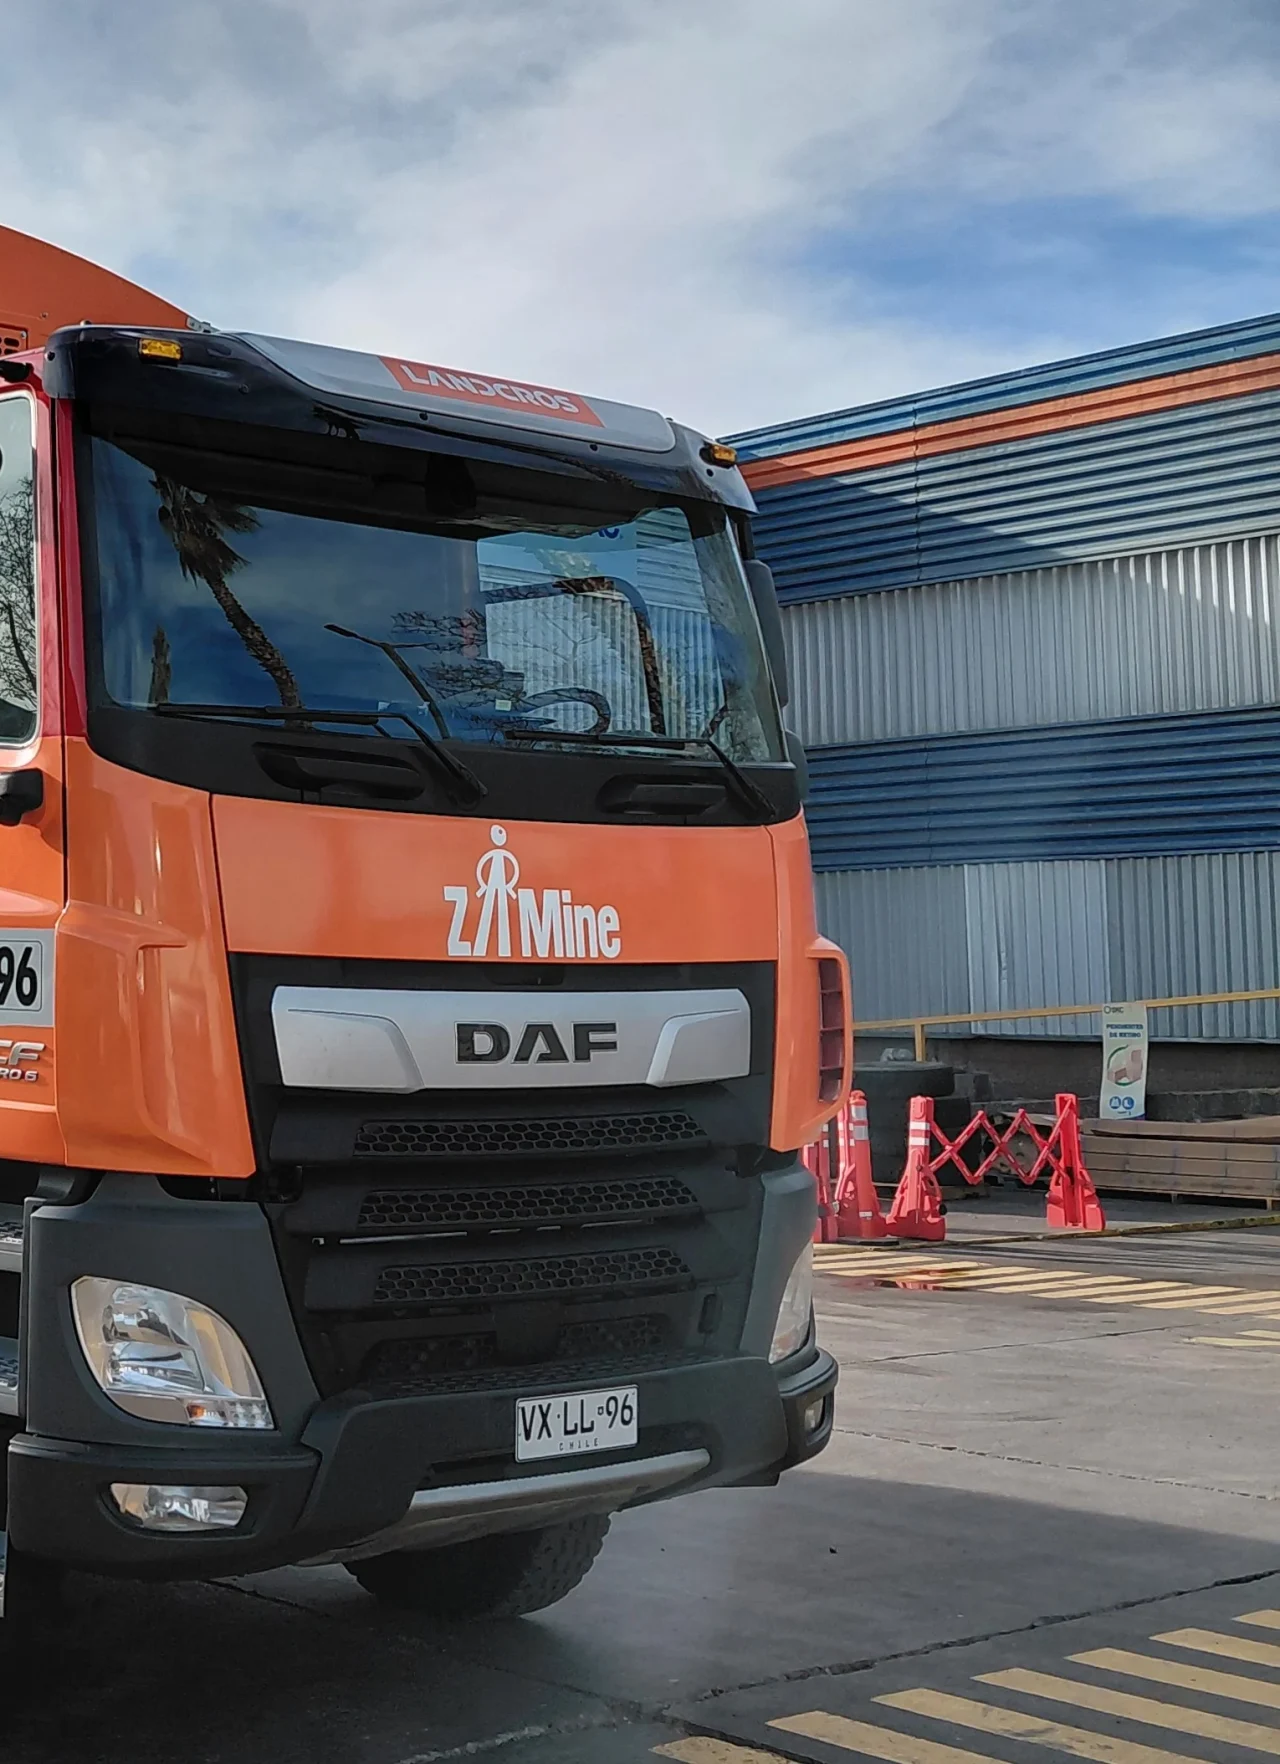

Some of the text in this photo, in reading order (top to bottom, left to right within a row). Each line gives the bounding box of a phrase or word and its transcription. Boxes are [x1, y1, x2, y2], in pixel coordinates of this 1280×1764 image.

[400, 364, 581, 414] LANDCROS
[454, 1021, 619, 1065] DAF
[24, 1070, 39, 1082] 6
[559, 1437, 600, 1451] CHILE
